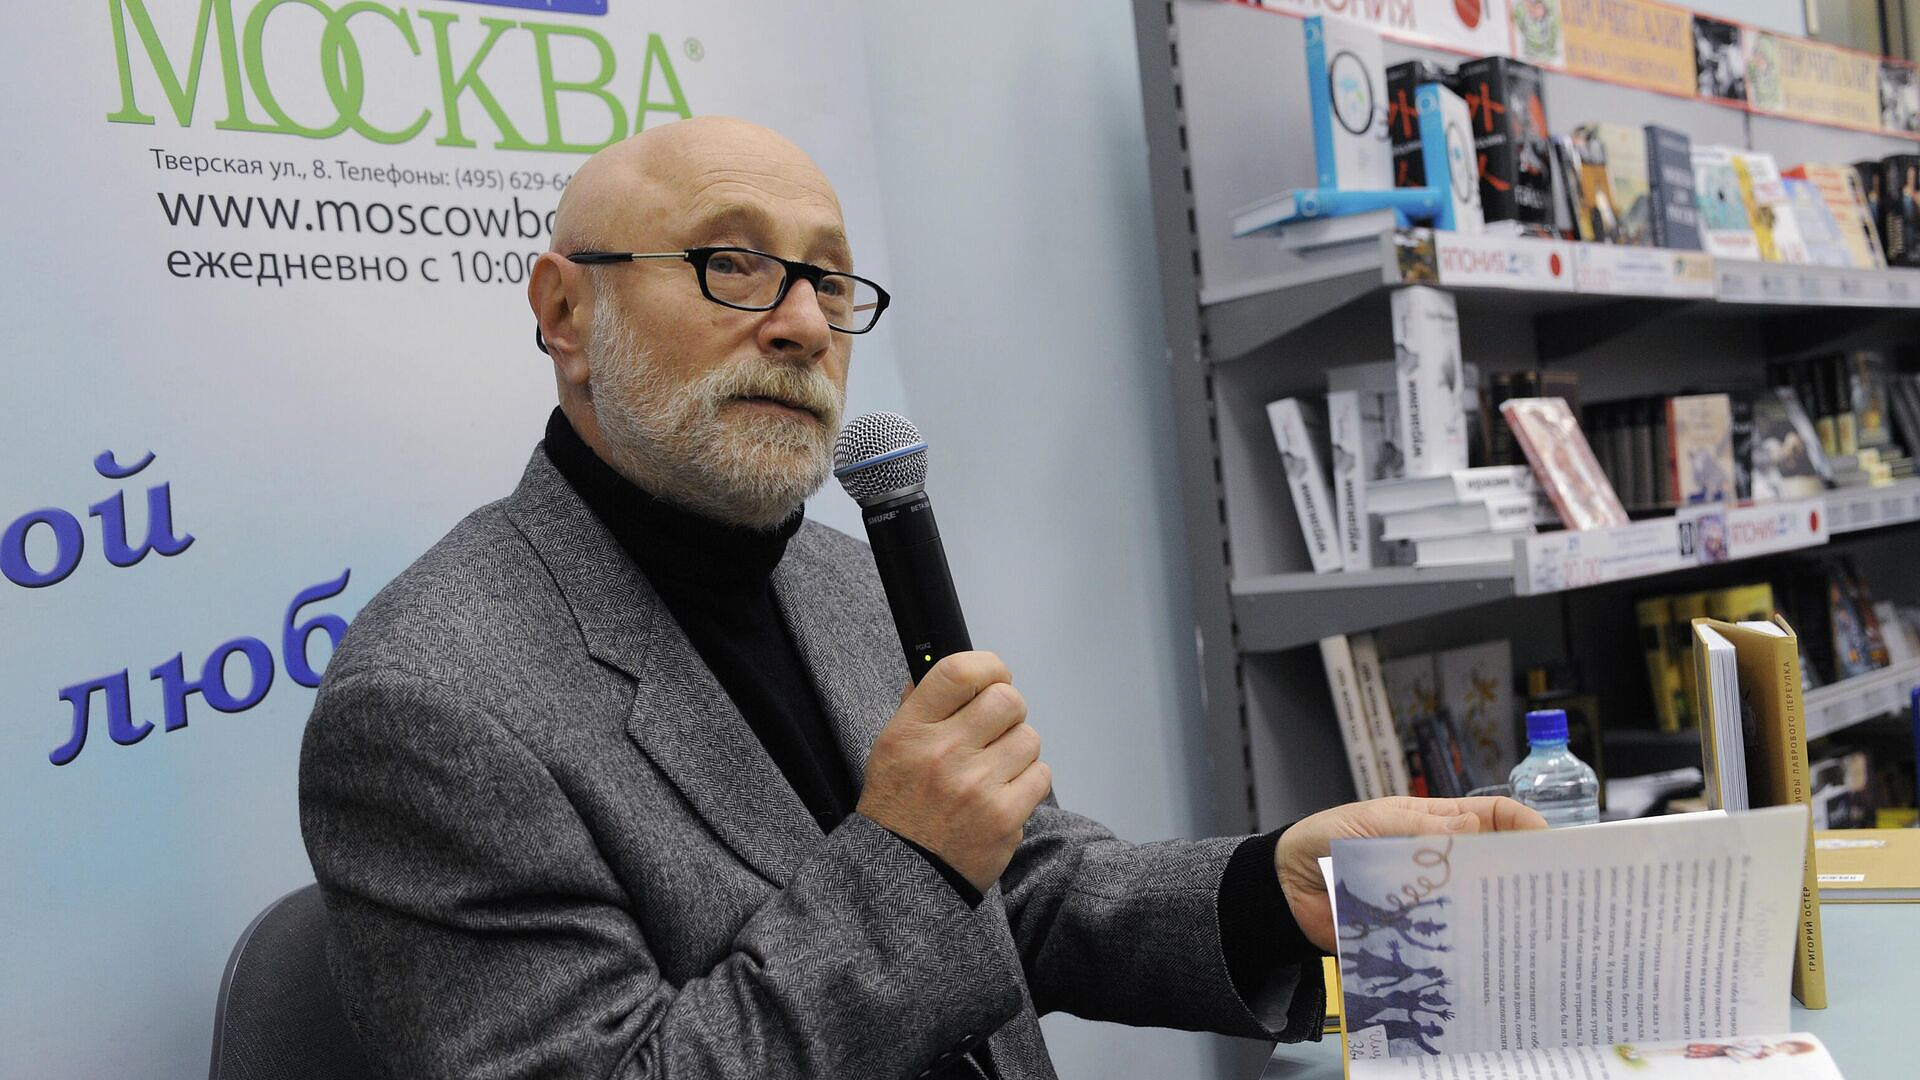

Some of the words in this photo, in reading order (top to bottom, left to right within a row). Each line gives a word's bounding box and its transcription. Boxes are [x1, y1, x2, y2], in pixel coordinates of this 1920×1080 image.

[150, 148, 263, 176] Тверская
[269, 161, 307, 181] ул.,
[313, 159, 332, 180] 8.
[335, 160, 450, 188] Телефоны:
[455, 166, 505, 192] (495)
[167, 250, 408, 288] ежедневно
[421, 257, 440, 283] с
[0, 449, 195, 589] ой
[1782, 661, 1795, 711] ПЕРЕУЛКА
[1793, 778, 1803, 804] ИФЫ
[1802, 886, 1813, 918] ОСТЕР
[1804, 920, 1817, 972] ГРИГОРИЙ
[1560, 980, 1568, 1012] осталось
[1591, 984, 1599, 1017] никаких
[1604, 990, 1614, 1023] выросли
[1574, 992, 1585, 1040] устраивала,
